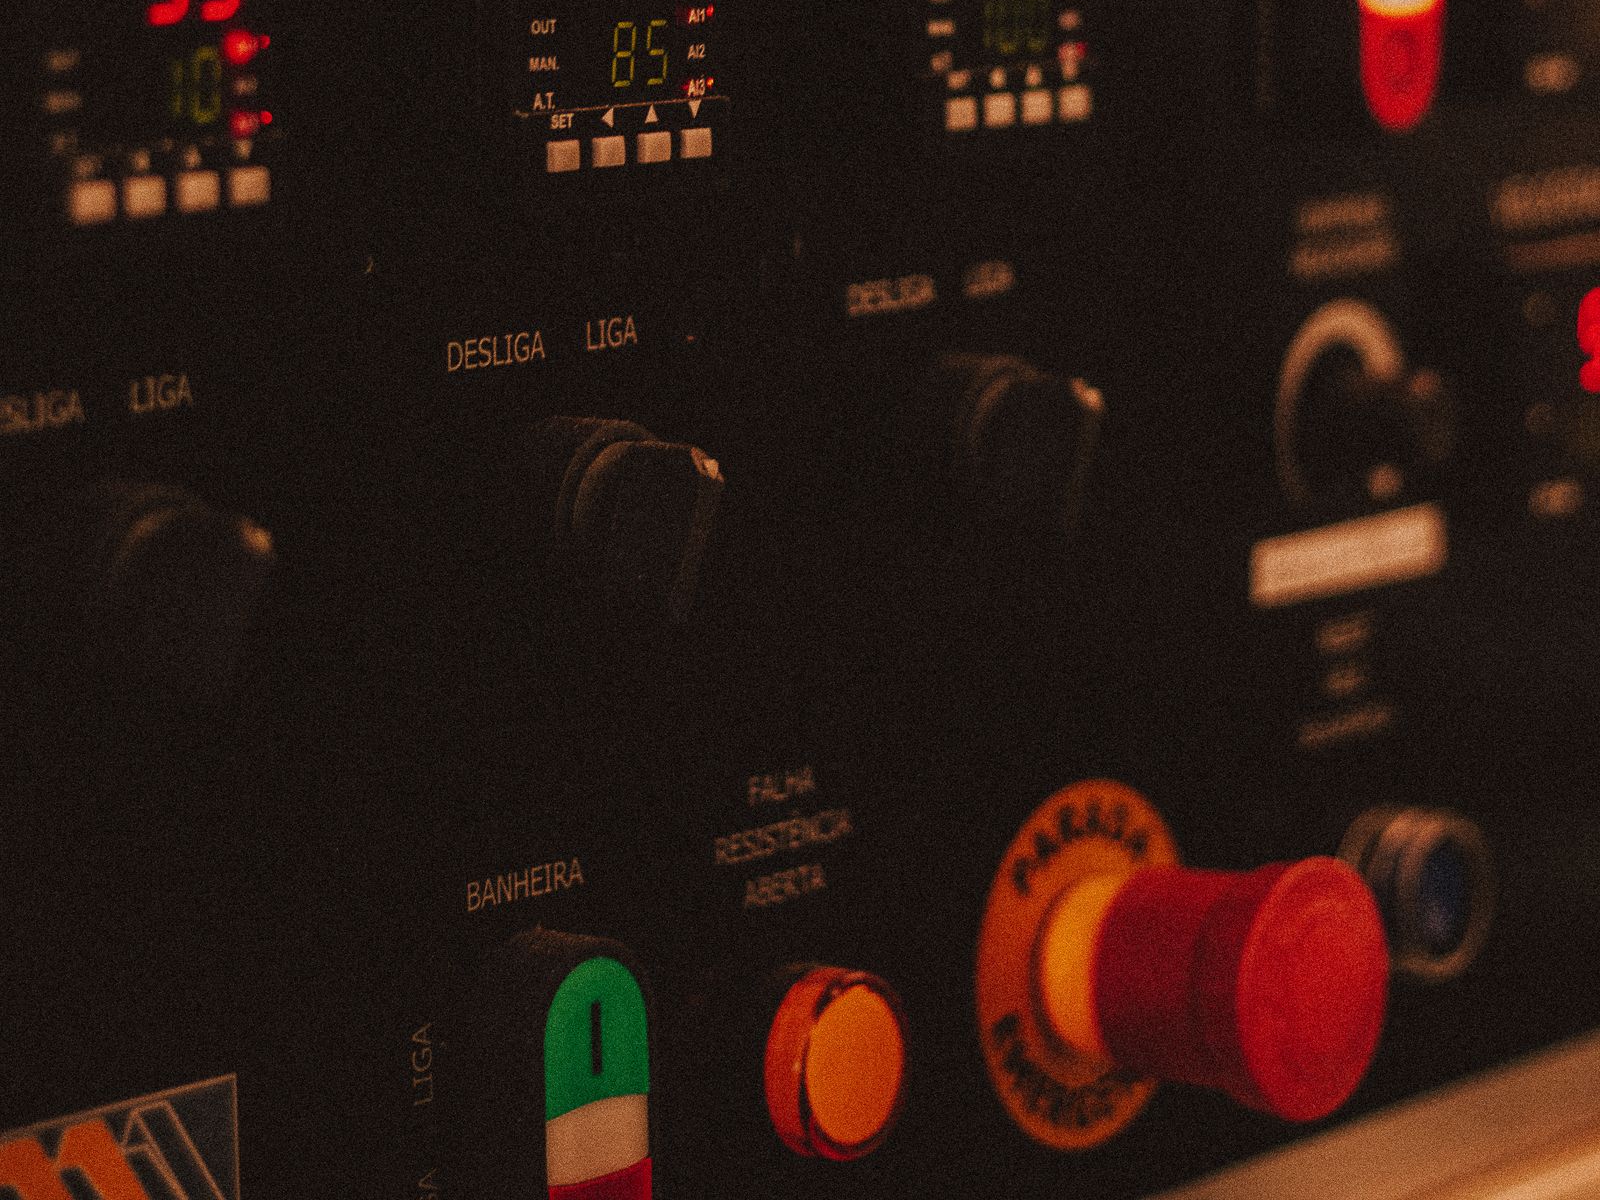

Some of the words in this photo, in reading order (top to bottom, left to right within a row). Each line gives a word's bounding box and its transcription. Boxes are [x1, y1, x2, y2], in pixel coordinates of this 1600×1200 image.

[530, 18, 557, 36] OUT
[611, 18, 669, 88] 85
[550, 112, 575, 130] SET
[447, 328, 546, 373] DESLIGA
[585, 312, 639, 352] LIGA
[128, 372, 192, 415] LIGA
[465, 856, 587, 913] BANHEIRA
[410, 1022, 434, 1106] LIGA
